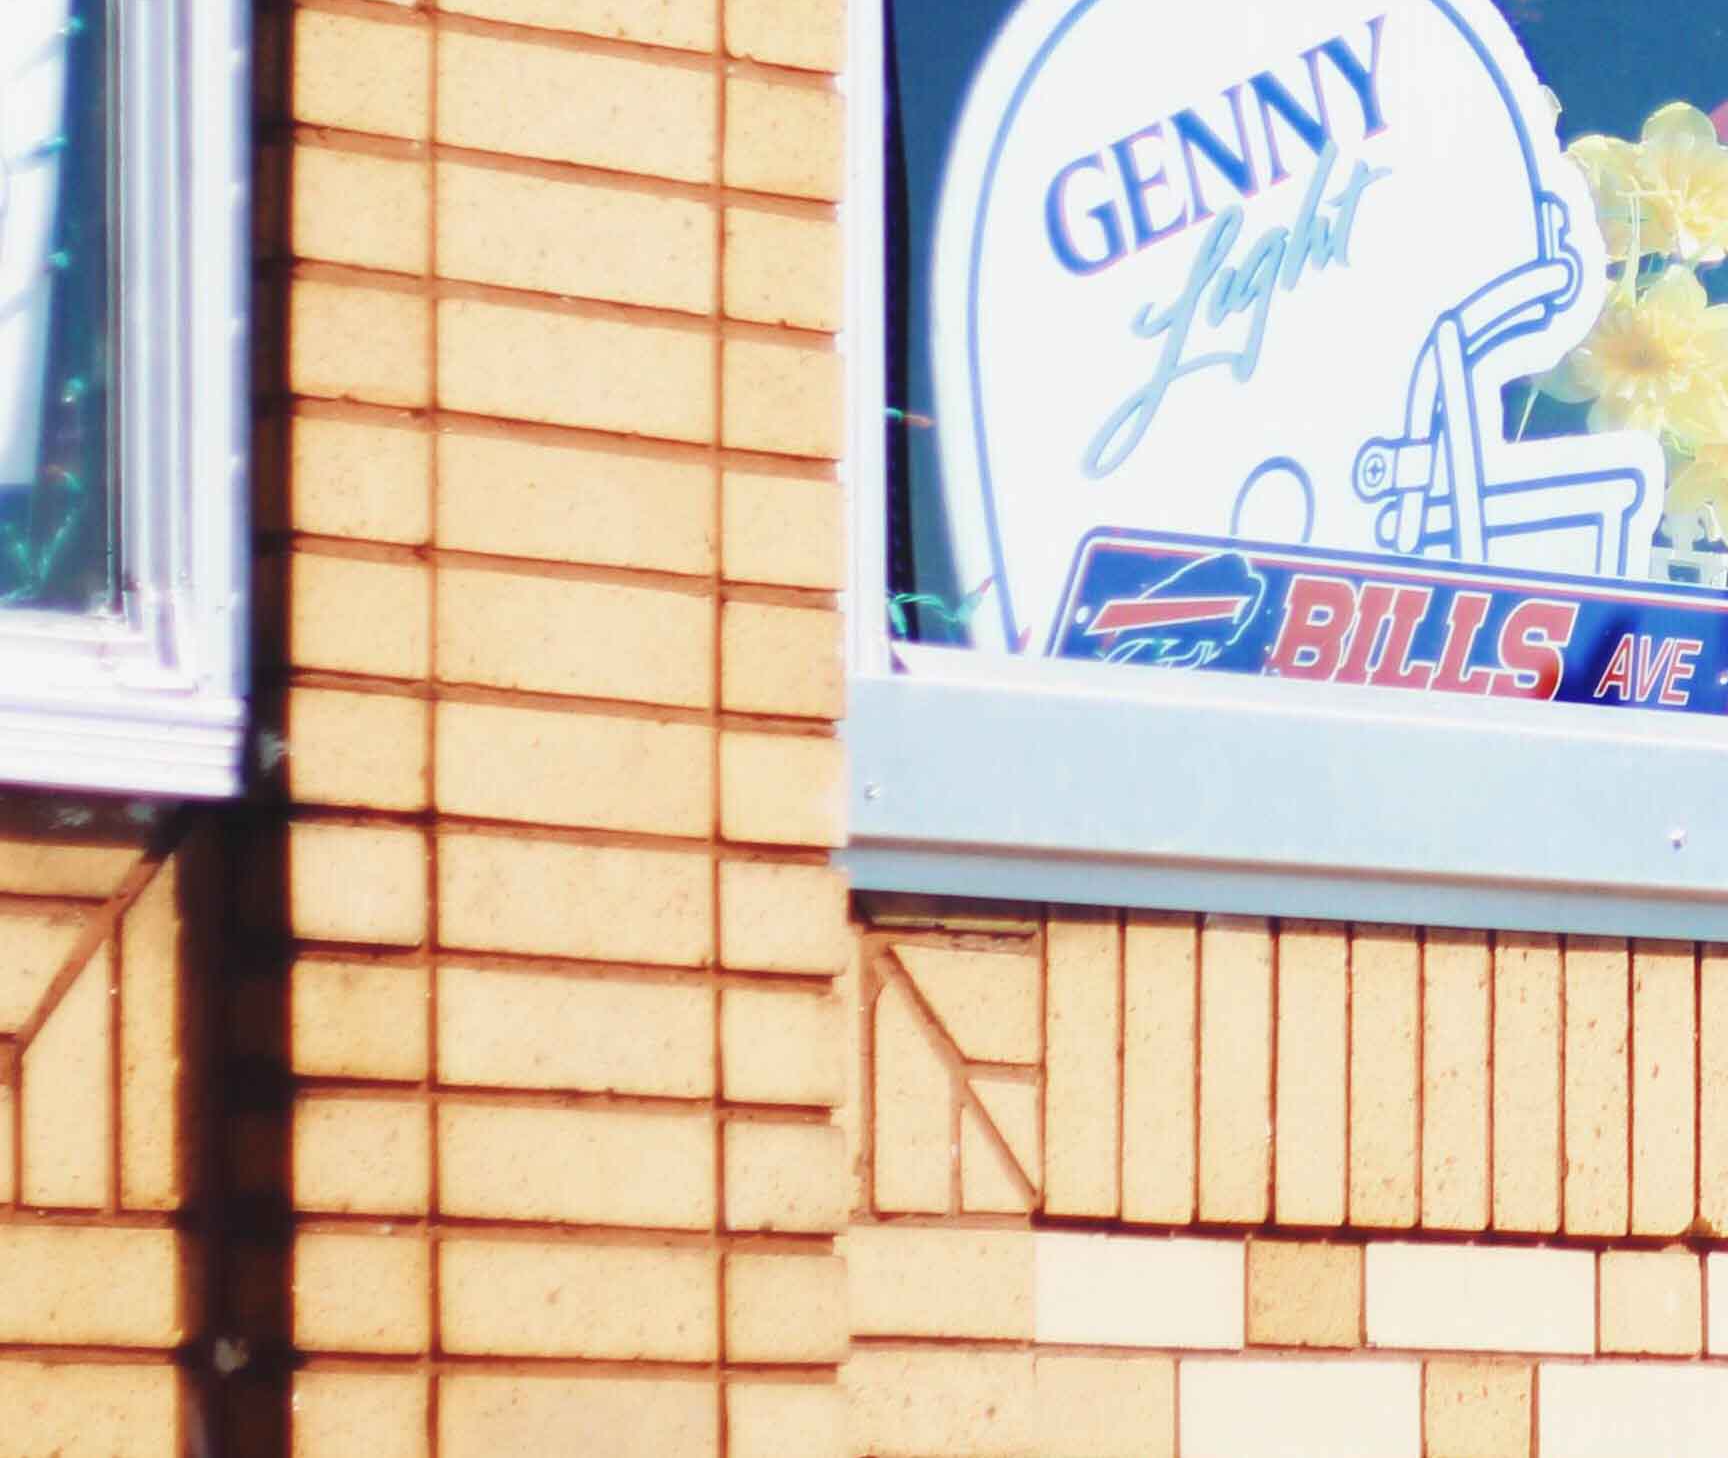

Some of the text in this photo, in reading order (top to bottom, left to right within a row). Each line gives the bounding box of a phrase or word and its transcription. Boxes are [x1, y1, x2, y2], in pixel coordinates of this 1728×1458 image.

[1044, 14, 1390, 278] GENNY
[1082, 142, 1393, 480] Light
[1263, 572, 1703, 706] BILLS AVE
